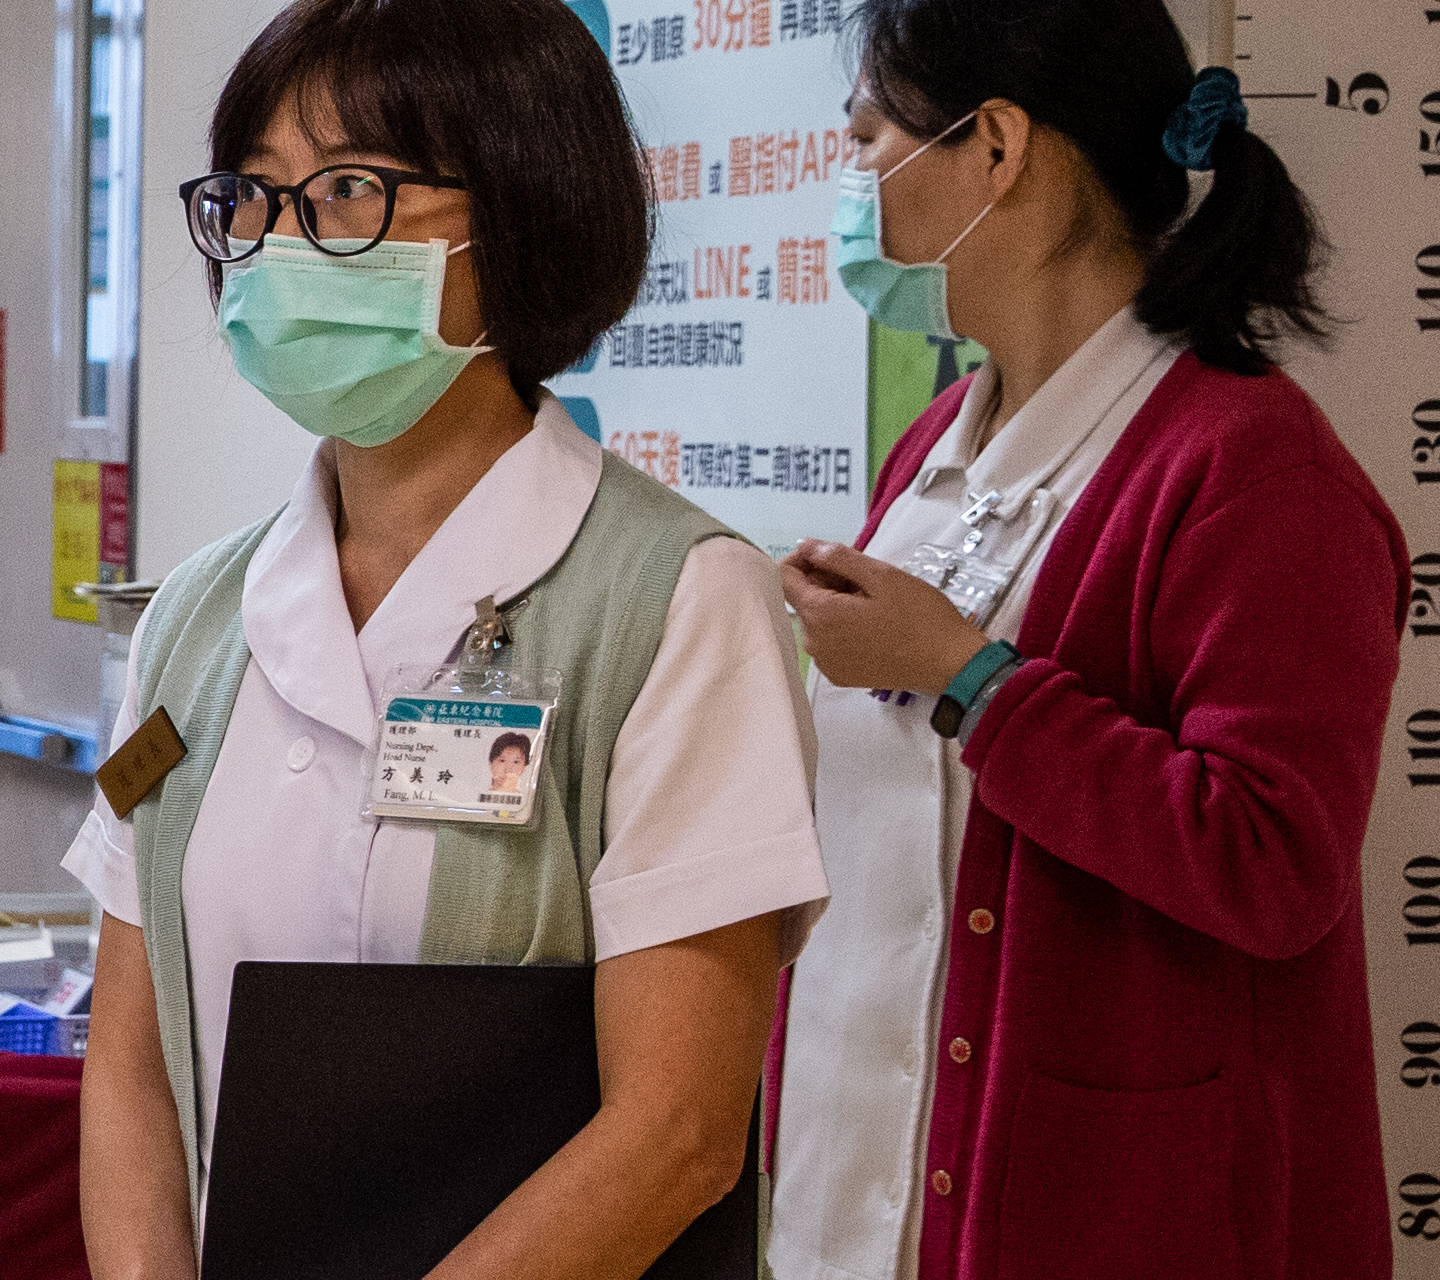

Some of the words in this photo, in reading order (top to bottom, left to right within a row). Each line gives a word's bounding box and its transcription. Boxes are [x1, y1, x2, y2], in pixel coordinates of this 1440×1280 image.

[1325, 71, 1391, 117] 5
[693, 244, 752, 301] LINE
[776, 236, 829, 306] 簡訊
[383, 753, 403, 762] Head
[404, 753, 427, 762] Nurse
[385, 742, 414, 752] Nursing
[383, 789, 410, 802] Fang,
[1402, 855, 1440, 947] 100
[1399, 1021, 1440, 1090] 90
[1397, 1172, 1440, 1242] 80
